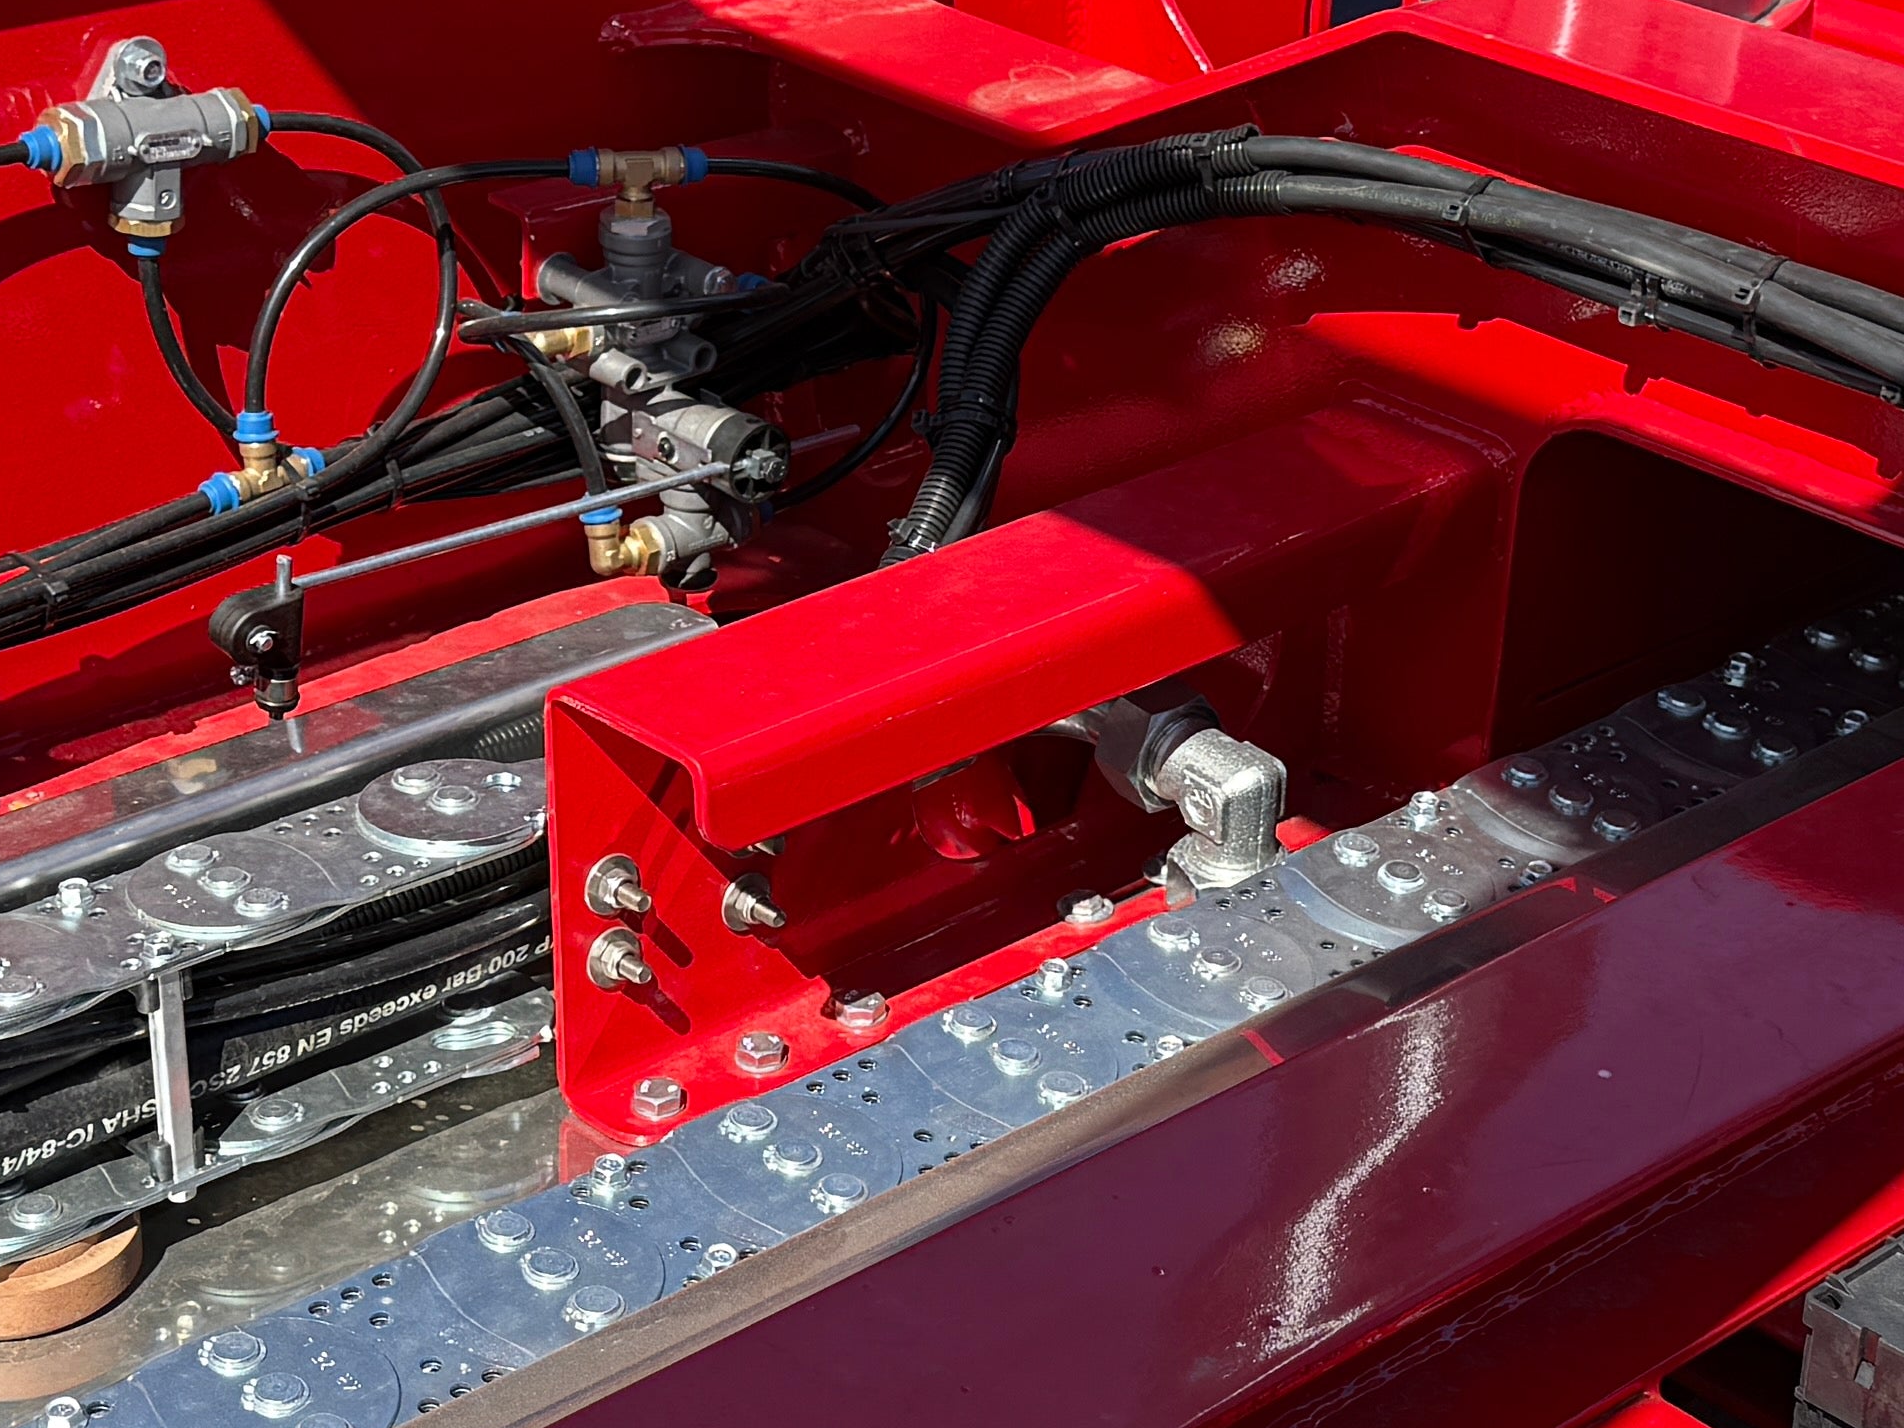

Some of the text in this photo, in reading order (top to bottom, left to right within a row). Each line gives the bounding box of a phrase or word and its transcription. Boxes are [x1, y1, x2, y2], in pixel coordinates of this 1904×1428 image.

[488, 943, 530, 973] 200
[534, 934, 553, 955] P
[442, 963, 482, 993] Bar
[339, 983, 437, 1036] exceeds
[296, 1026, 332, 1058] EN
[246, 1043, 290, 1077] 857
[102, 1097, 158, 1134] SHA
